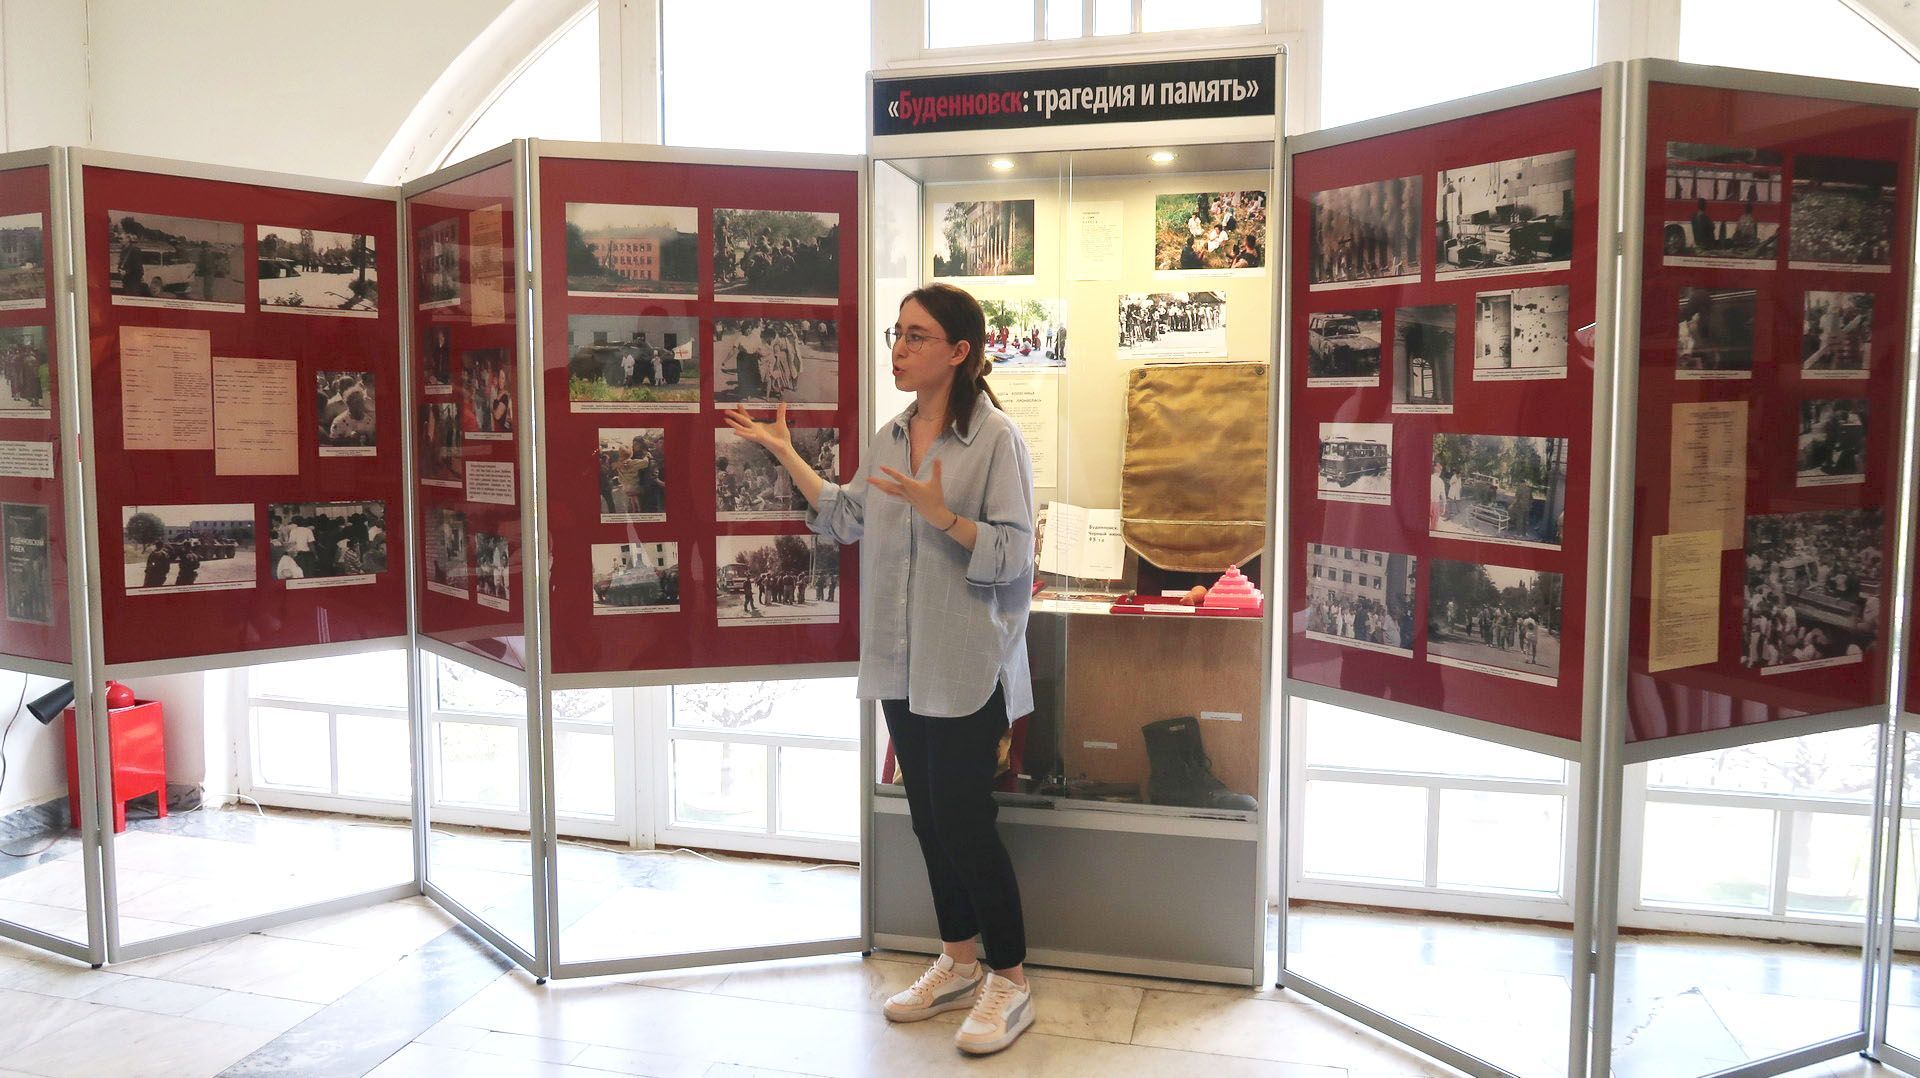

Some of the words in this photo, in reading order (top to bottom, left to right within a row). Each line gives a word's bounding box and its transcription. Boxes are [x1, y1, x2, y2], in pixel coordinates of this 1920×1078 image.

[888, 89, 1028, 126] «Буденновск:
[1034, 84, 1135, 119] трагедия
[1141, 83, 1154, 106] и
[1160, 78, 1259, 105] память»
